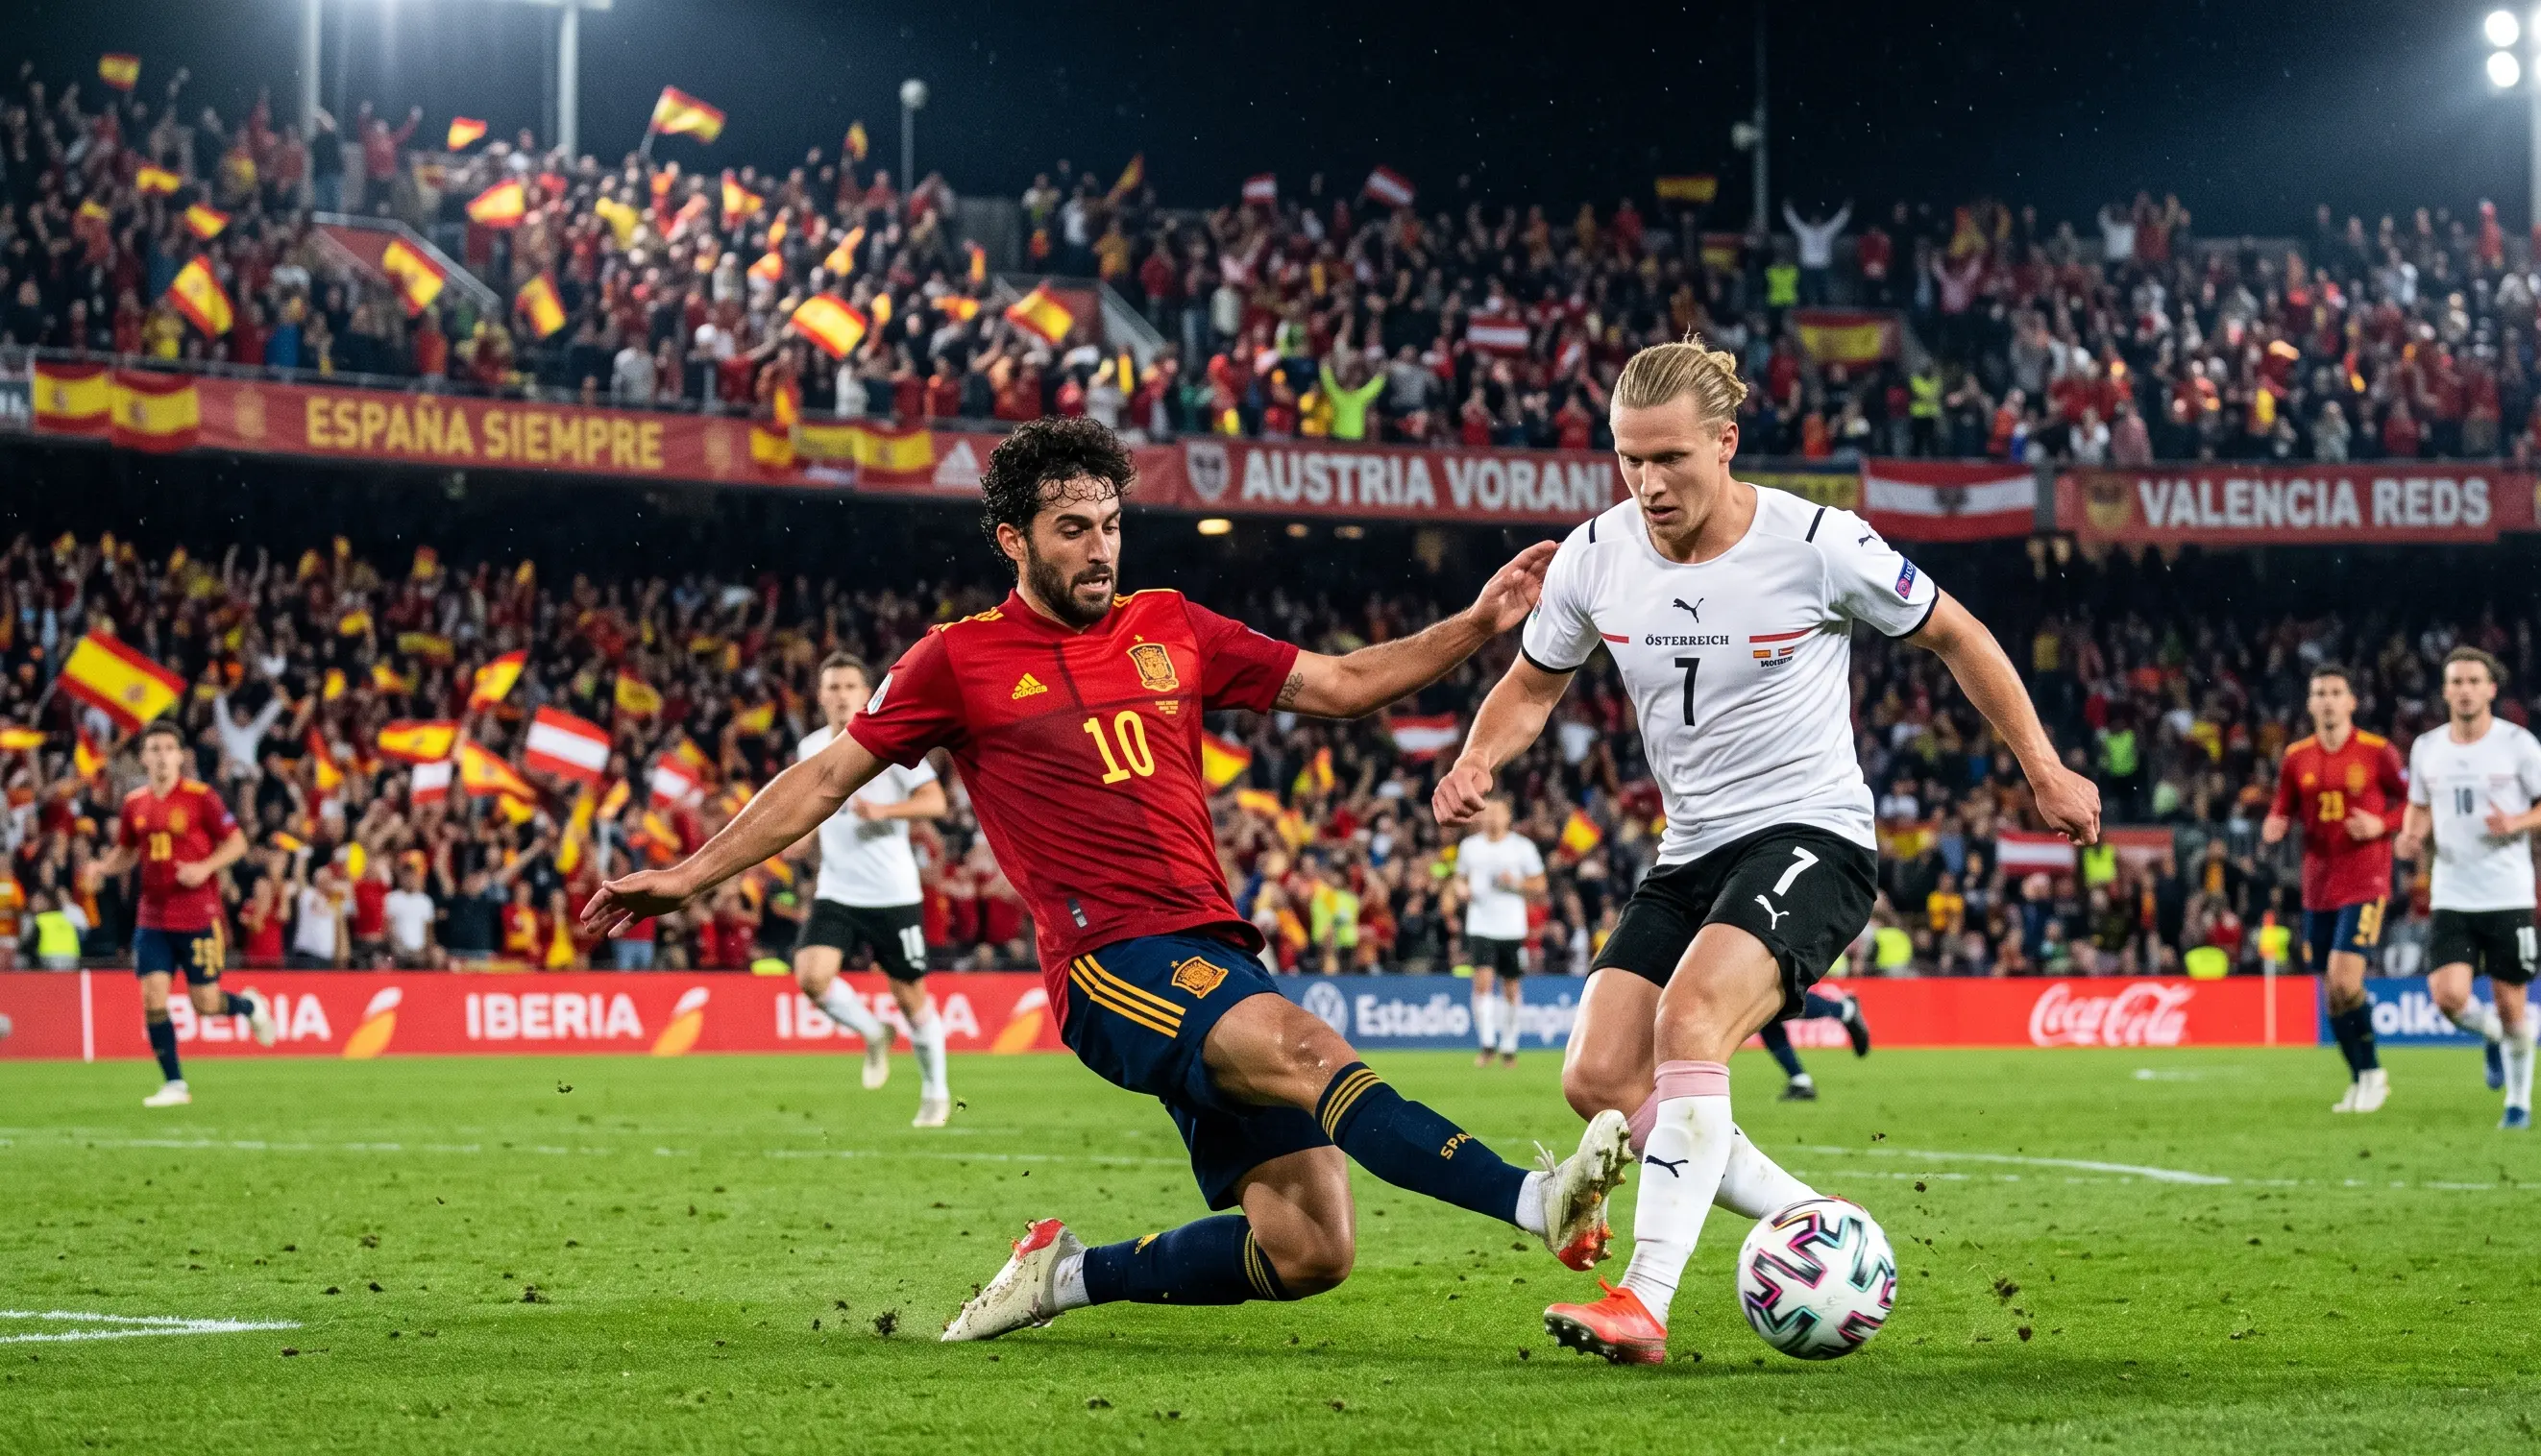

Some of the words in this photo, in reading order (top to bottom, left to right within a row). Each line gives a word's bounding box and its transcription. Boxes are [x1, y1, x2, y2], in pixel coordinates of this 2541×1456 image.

[305, 395, 475, 456] ESPAÑA
[483, 408, 666, 470] SIEMPRE
[1241, 450, 1437, 507] AUSTRIA
[2138, 478, 2361, 527] VALENCIA
[2372, 477, 2491, 526] REDS
[1645, 634, 1729, 645] ÖSTERREICH
[1674, 658, 1700, 727] 7
[1083, 710, 1155, 784] 10
[1772, 846, 1820, 897] 7
[465, 992, 645, 1040] IBERIA
[775, 992, 981, 1040] IBRA
[1356, 993, 1471, 1036] Estadio
